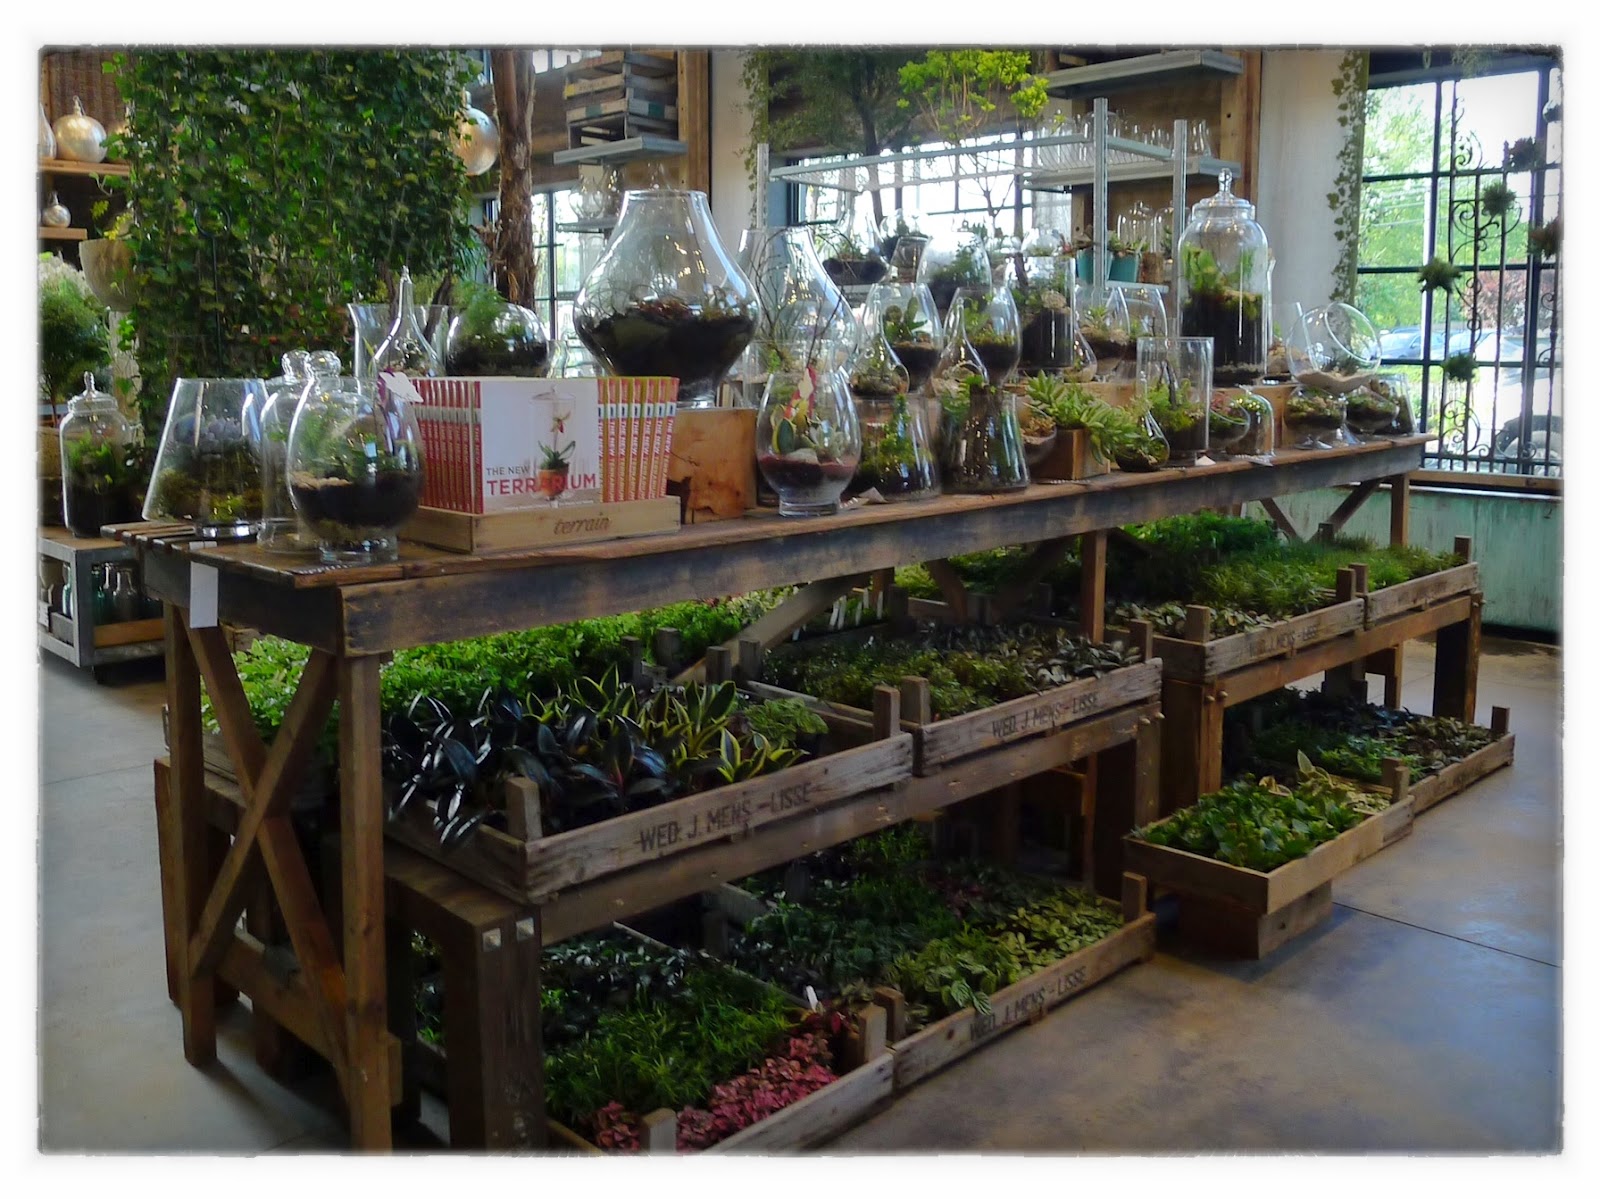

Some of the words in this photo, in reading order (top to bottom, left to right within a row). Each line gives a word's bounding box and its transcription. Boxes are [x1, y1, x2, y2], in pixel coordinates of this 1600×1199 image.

[666, 418, 674, 433] THE
[664, 434, 672, 454] NEW
[486, 466, 505, 476] THE
[508, 465, 530, 475] NEW
[486, 473, 596, 495] TERRARIUM
[553, 511, 610, 535] terrain
[707, 801, 752, 833] MENS
